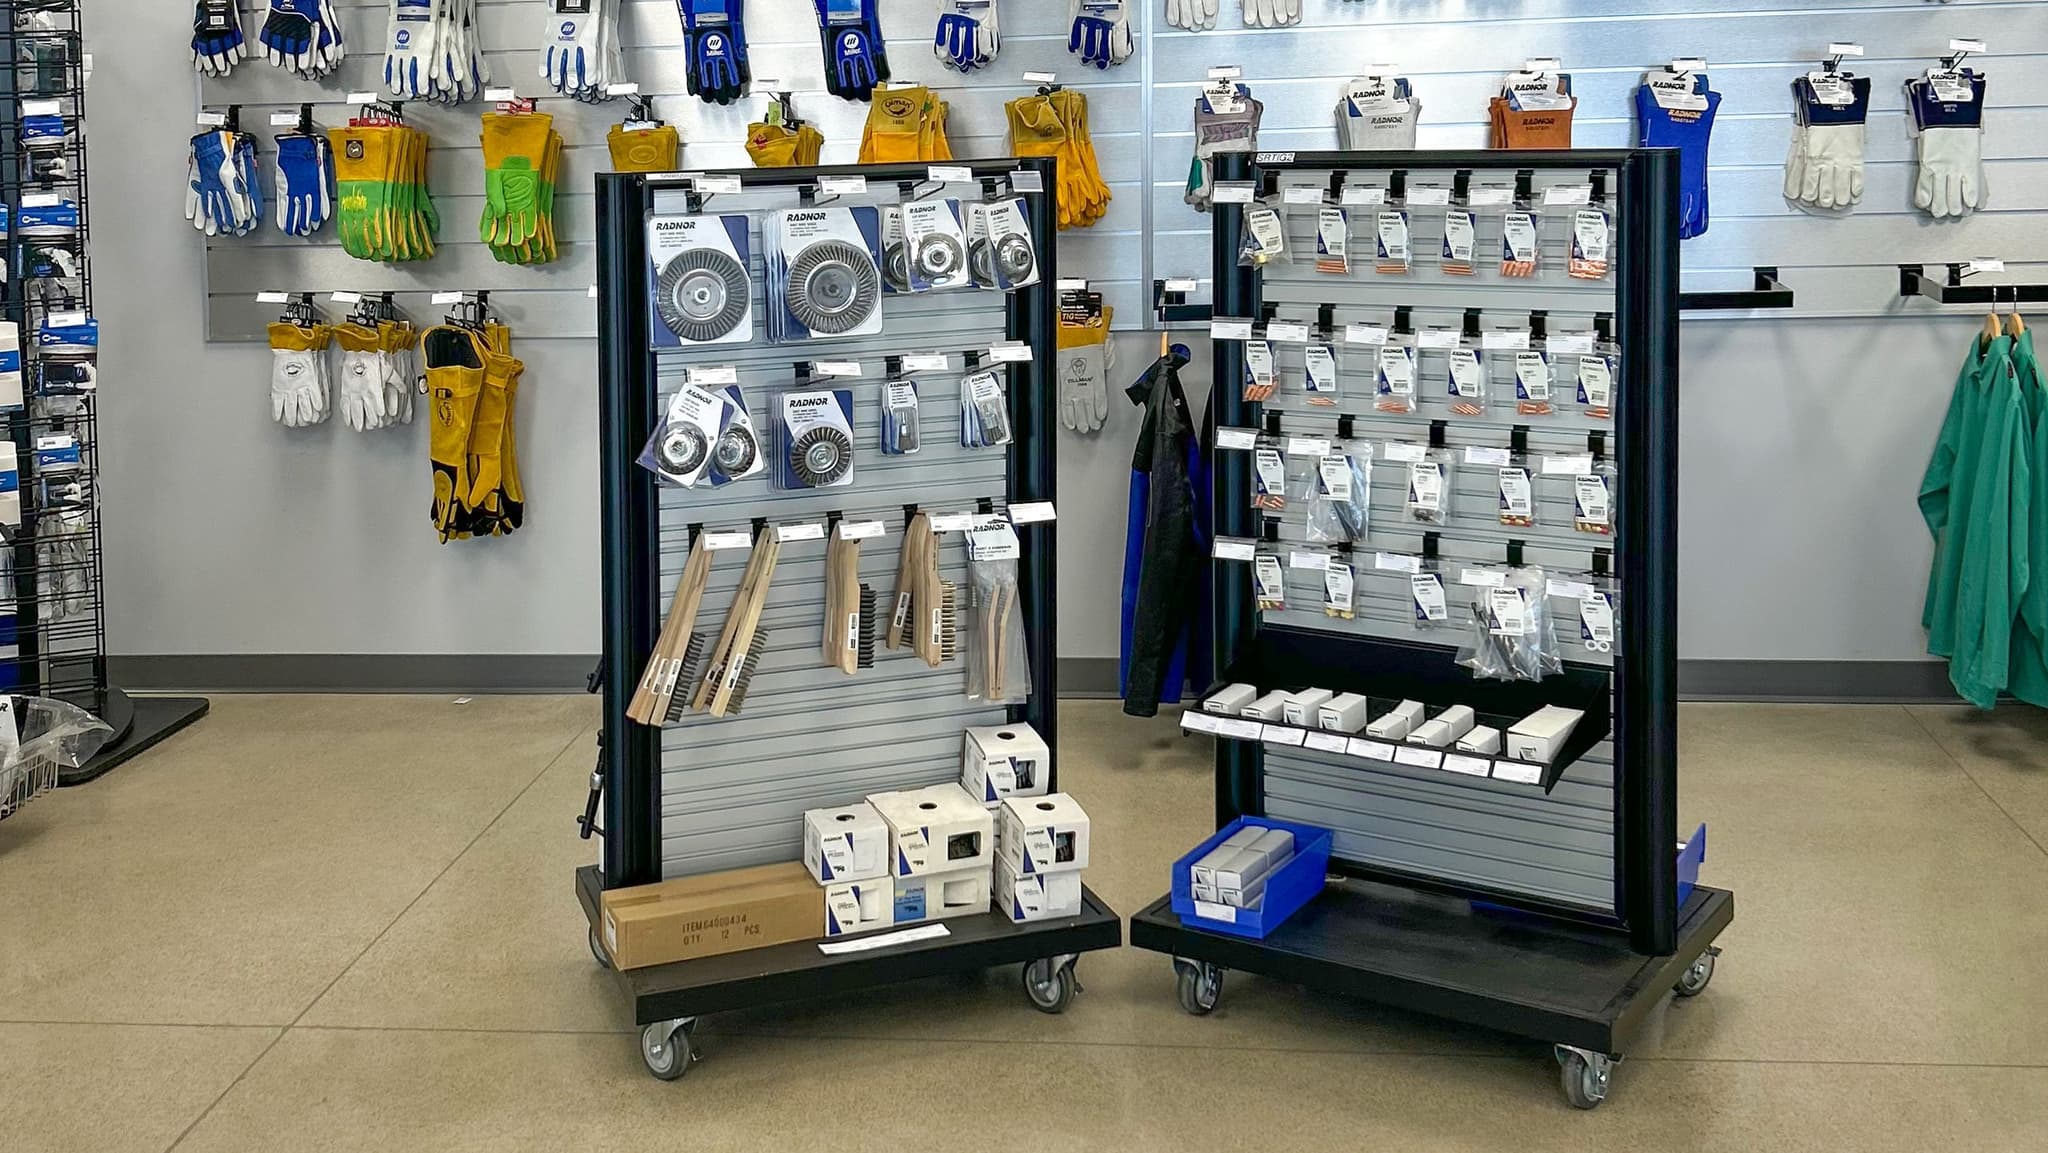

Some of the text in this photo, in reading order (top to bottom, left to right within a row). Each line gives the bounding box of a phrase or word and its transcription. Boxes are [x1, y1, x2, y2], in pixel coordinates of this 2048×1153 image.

[1514, 83, 1548, 91] RADNOR
[1652, 81, 1686, 90] RADNOR
[1353, 90, 1386, 98] RADNOR
[1668, 109, 1702, 118] RADNOR
[1371, 116, 1403, 124] RADNOR
[1522, 118, 1554, 126] RADNOR
[1257, 153, 1294, 162] SRTIG2
[909, 206, 936, 214] RADNOR
[786, 212, 826, 222] RADNOR
[656, 222, 696, 231] RADNOR
[686, 388, 712, 405] RADNOR
[789, 398, 828, 408] RADNOR
[974, 524, 1006, 532] RADNOR
